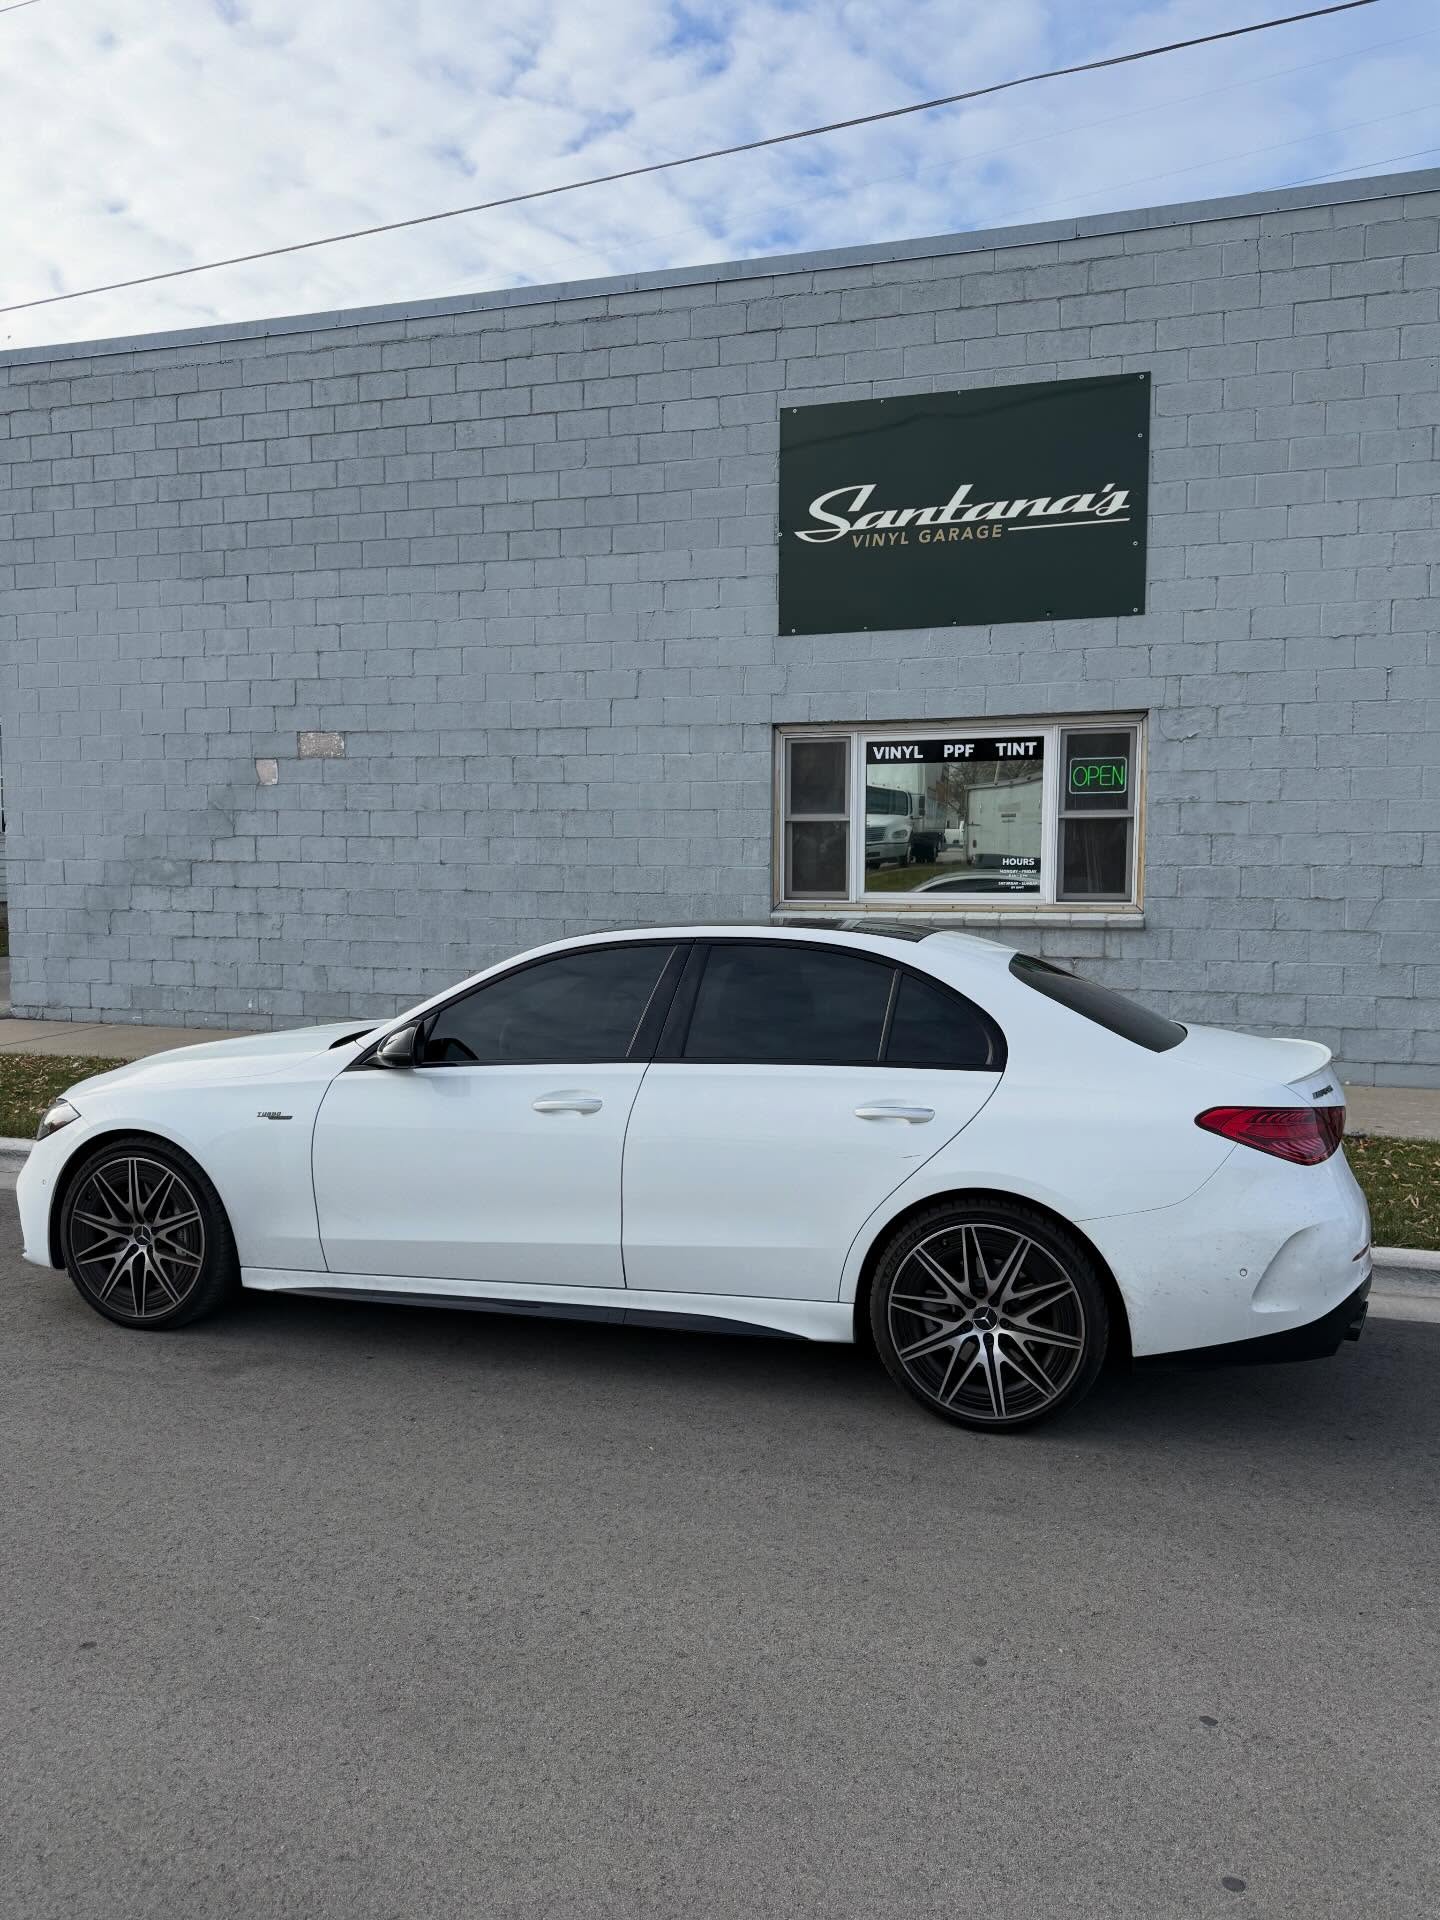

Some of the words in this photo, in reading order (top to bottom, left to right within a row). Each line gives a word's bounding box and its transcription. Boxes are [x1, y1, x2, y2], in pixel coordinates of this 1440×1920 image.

[794, 483, 1130, 543] Santana's
[852, 531, 909, 548] VINYL
[918, 524, 1003, 544] GARAGE
[872, 745, 924, 760] VINYL
[943, 743, 975, 758] PPF
[995, 741, 1038, 757] TINT
[1072, 765, 1124, 787] OPEN
[1002, 857, 1035, 866] HOURS
